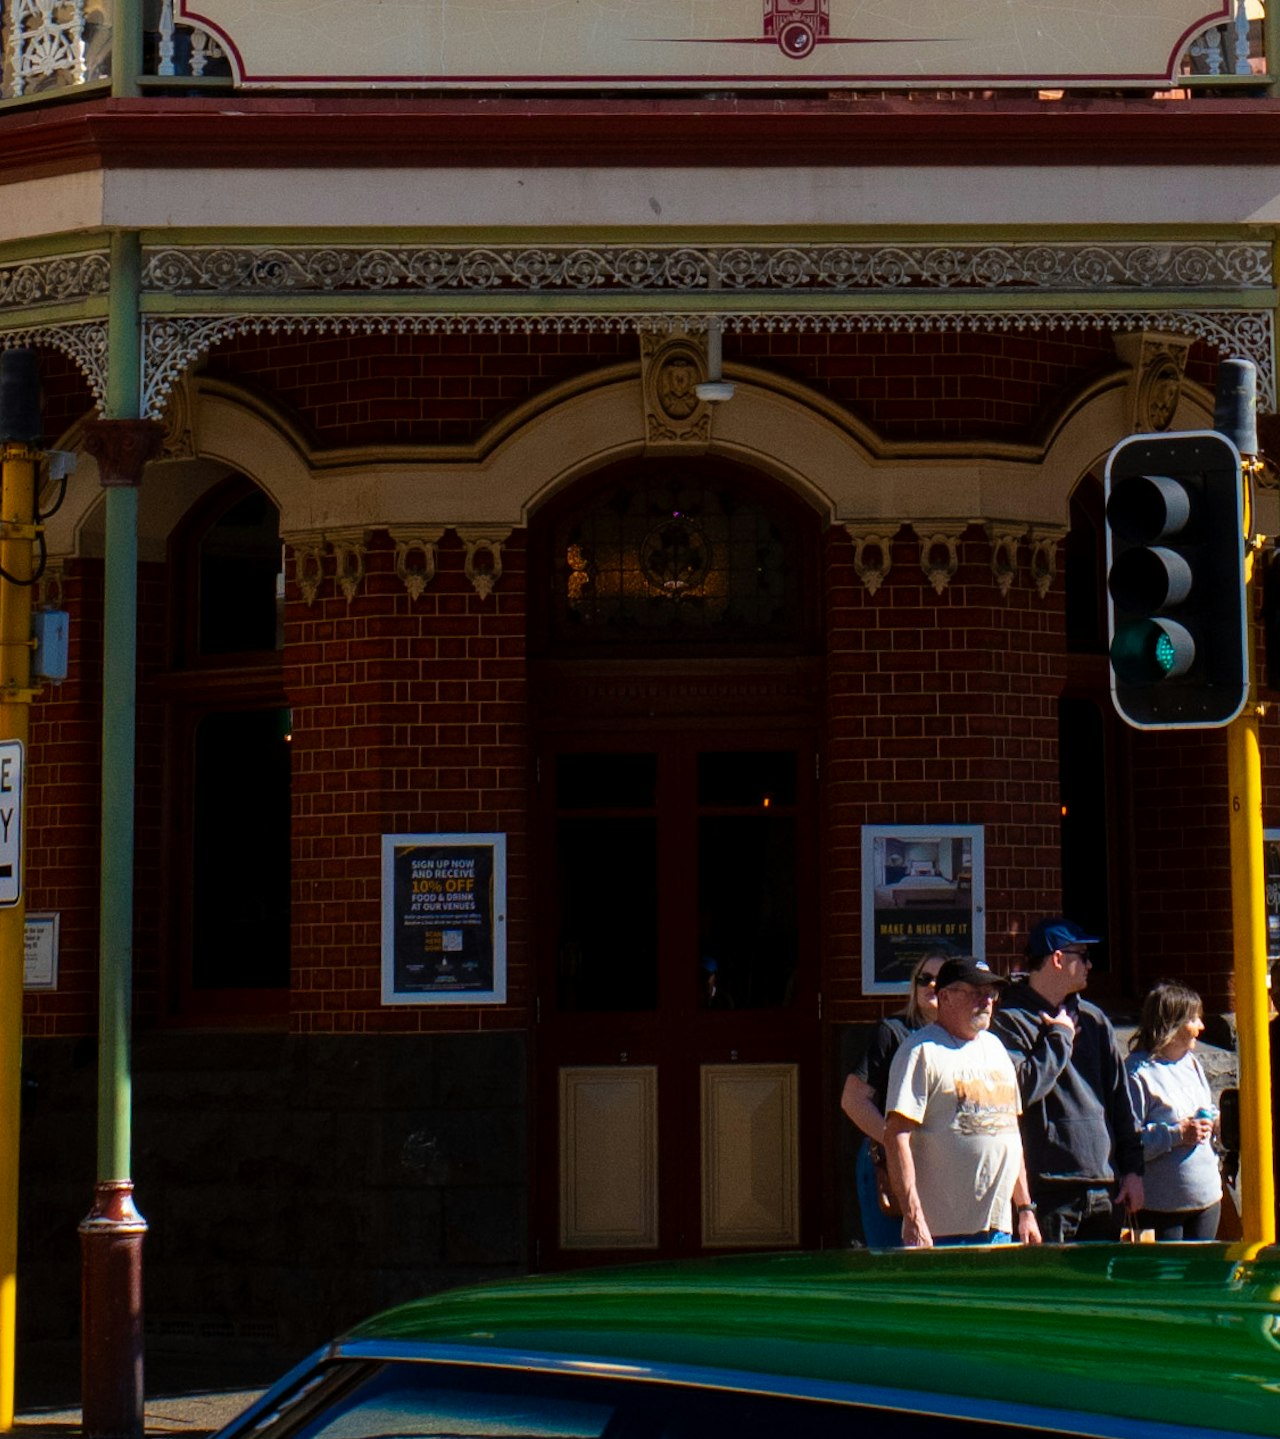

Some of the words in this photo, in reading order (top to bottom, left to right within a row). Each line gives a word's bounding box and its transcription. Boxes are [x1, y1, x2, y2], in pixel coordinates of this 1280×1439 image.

[1233, 796, 1241, 812] 6
[411, 859, 435, 869] SIGN
[436, 859, 450, 868] UP
[451, 859, 475, 868] NOW
[411, 869, 433, 878] AND
[434, 868, 475, 878] RECEIVE
[412, 880, 442, 893] 10%
[445, 879, 475, 892] OFF
[411, 893, 436, 902] FOOD
[437, 893, 444, 902] &
[446, 893, 474, 901] DRINK
[411, 903, 421, 911] AT
[422, 903, 442, 911] OUR
[442, 902, 476, 910] VENUES
[879, 923, 904, 935] MAKE
[907, 923, 913, 934] A
[916, 923, 942, 934] NIGHT
[945, 923, 956, 934] OF
[958, 923, 968, 934] IT
